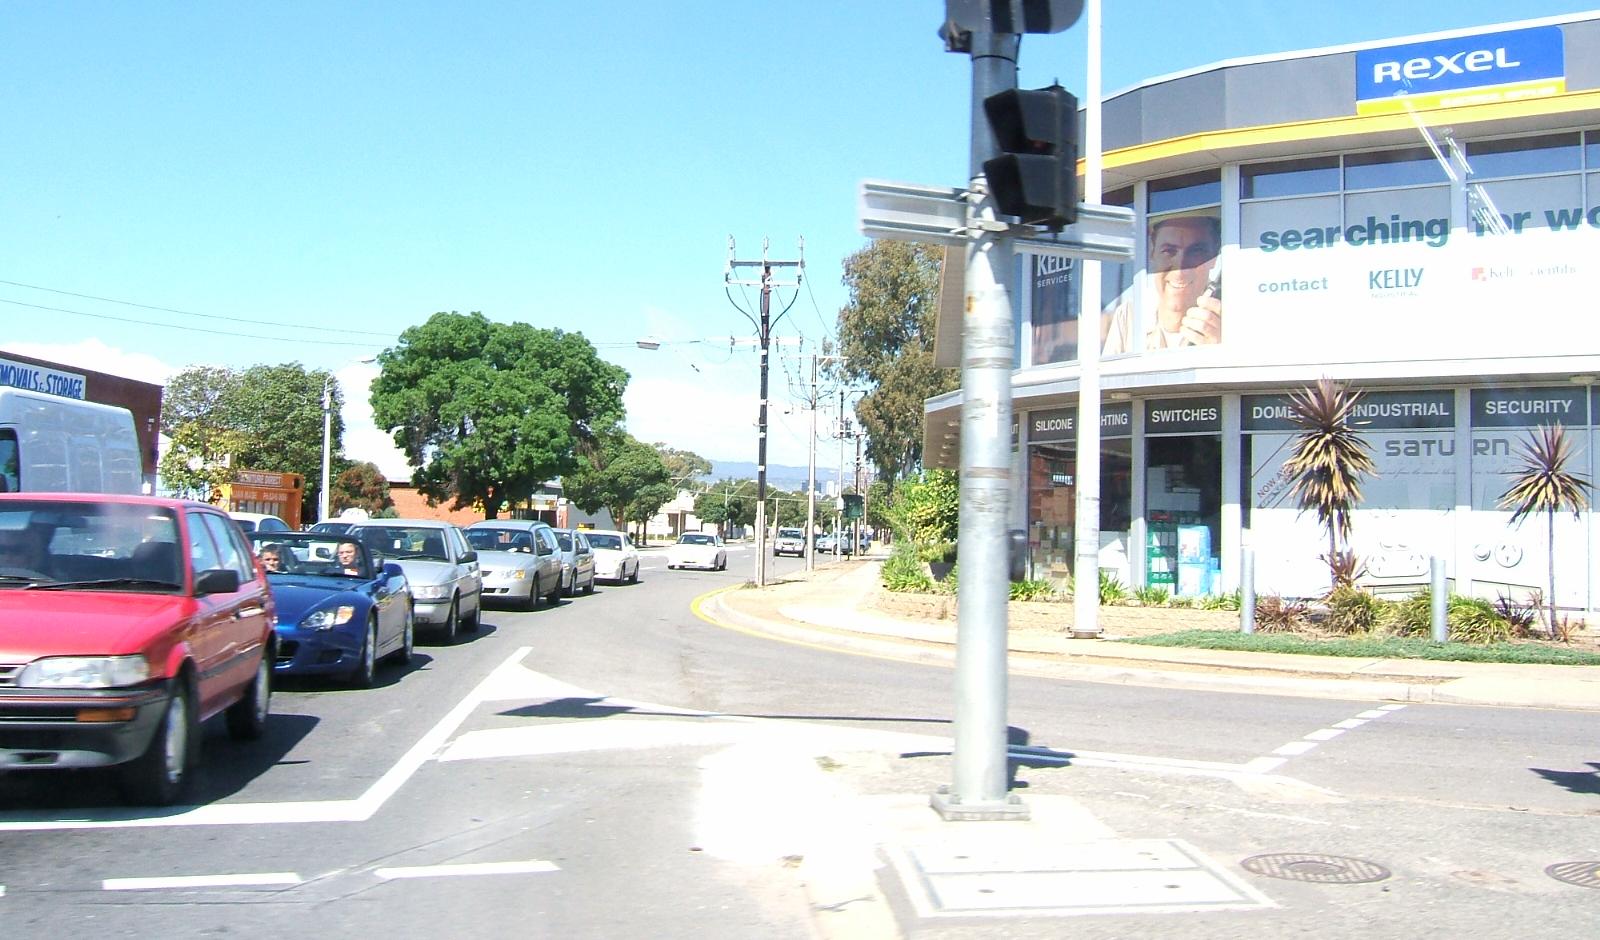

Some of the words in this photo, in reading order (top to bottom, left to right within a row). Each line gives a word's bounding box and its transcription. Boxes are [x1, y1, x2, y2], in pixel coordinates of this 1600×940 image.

[1259, 214, 1449, 253] searching
[1036, 273, 1073, 288] SERVICES
[1258, 277, 1329, 293] contact
[1369, 268, 1424, 290] KELLY
[0, 364, 40, 391] MOVALS
[46, 373, 83, 399] STORAGE
[1151, 407, 1218, 423] SWITCHES
[1352, 402, 1450, 417] INDUSTRIAL
[1485, 399, 1574, 415] SECURITY
[1035, 418, 1073, 432] SILICONE
[1100, 413, 1129, 427] HTING
